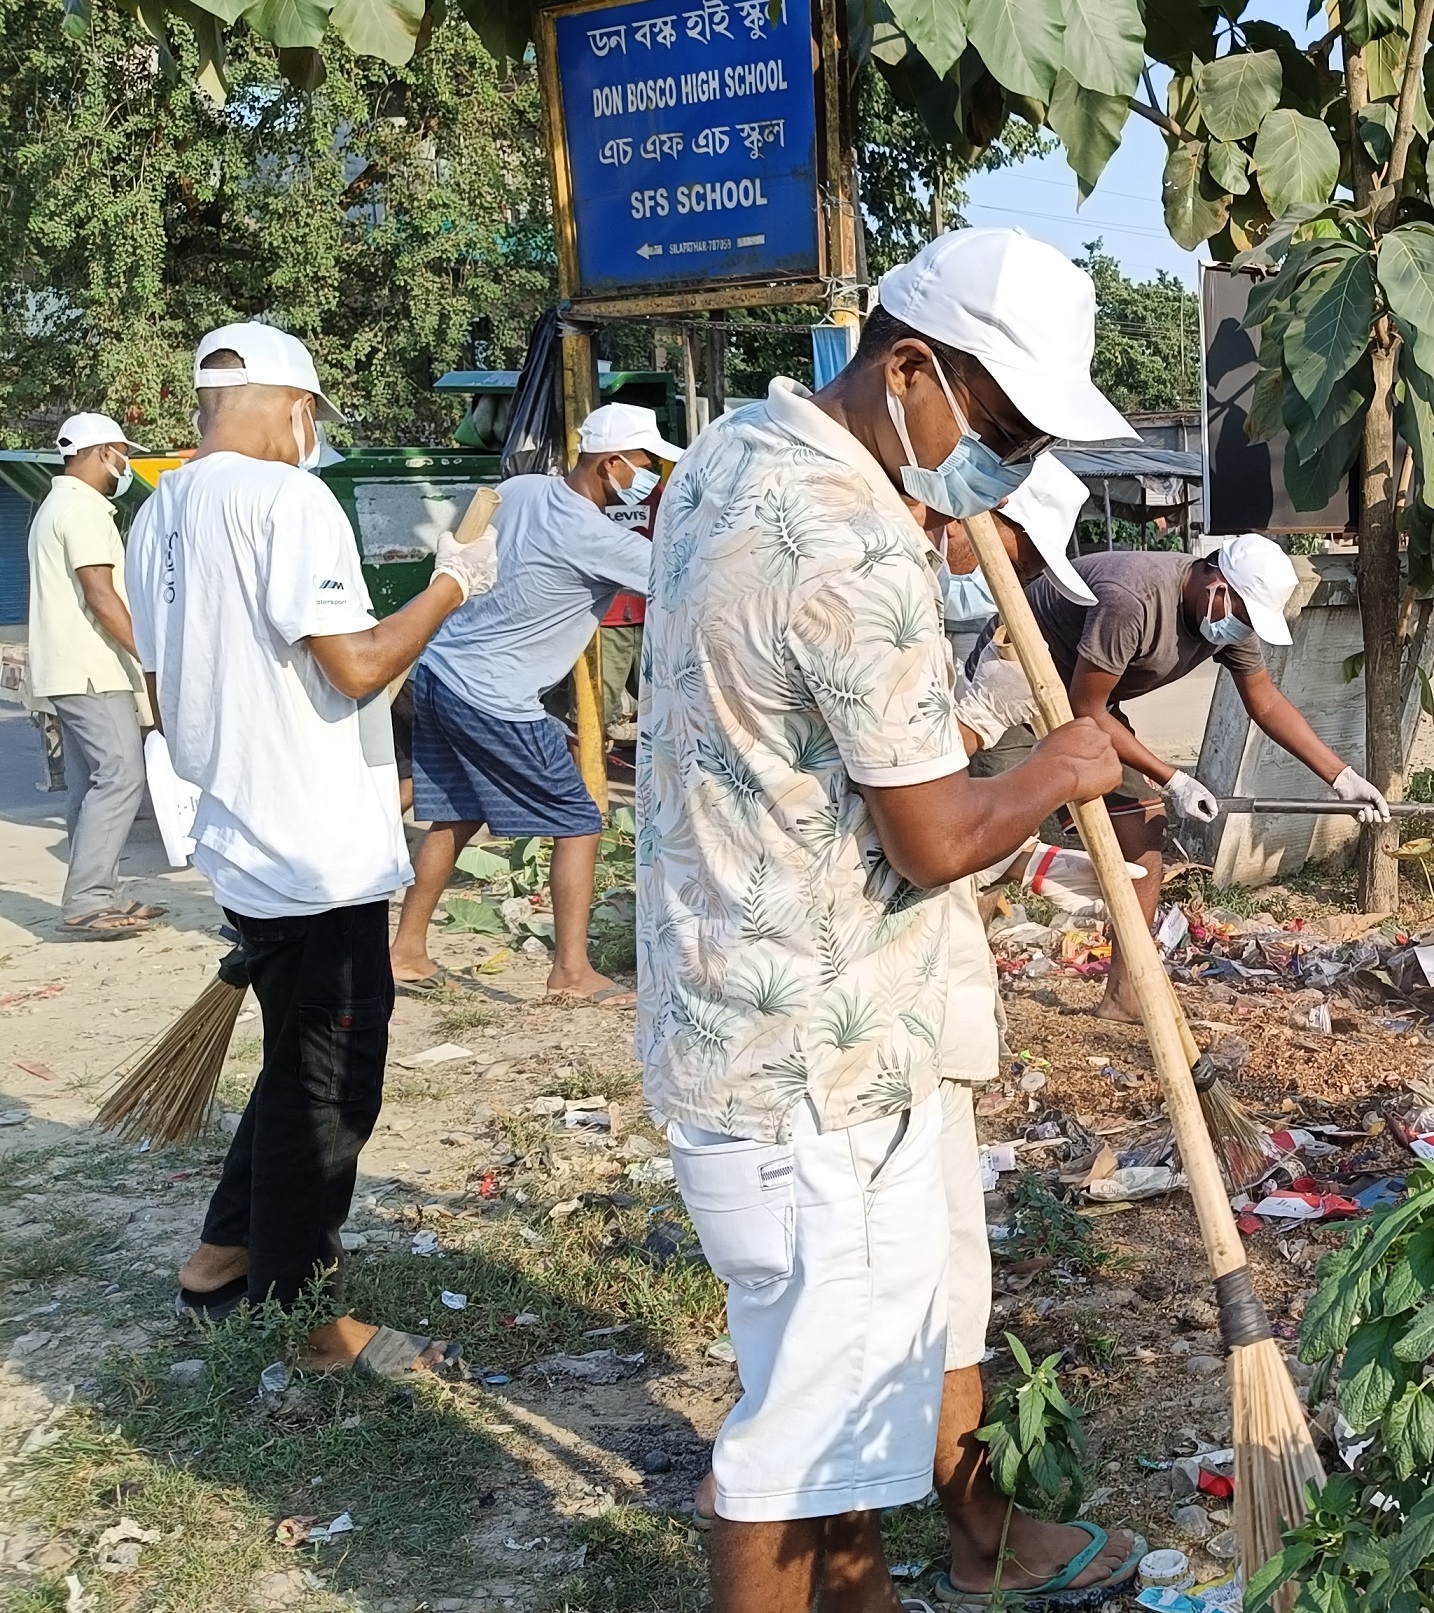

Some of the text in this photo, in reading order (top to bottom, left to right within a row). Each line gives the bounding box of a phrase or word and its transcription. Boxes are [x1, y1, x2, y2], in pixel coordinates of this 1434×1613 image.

[586, 25, 627, 57] ডন
[631, 15, 678, 50] বস্ক
[682, 0, 735, 45] হাই
[592, 59, 788, 118] DON BOSCO HIGH SCHOOL
[599, 119, 786, 167] এচ এফ এচ স্কুল
[630, 178, 768, 219] SFS SCHOOL
